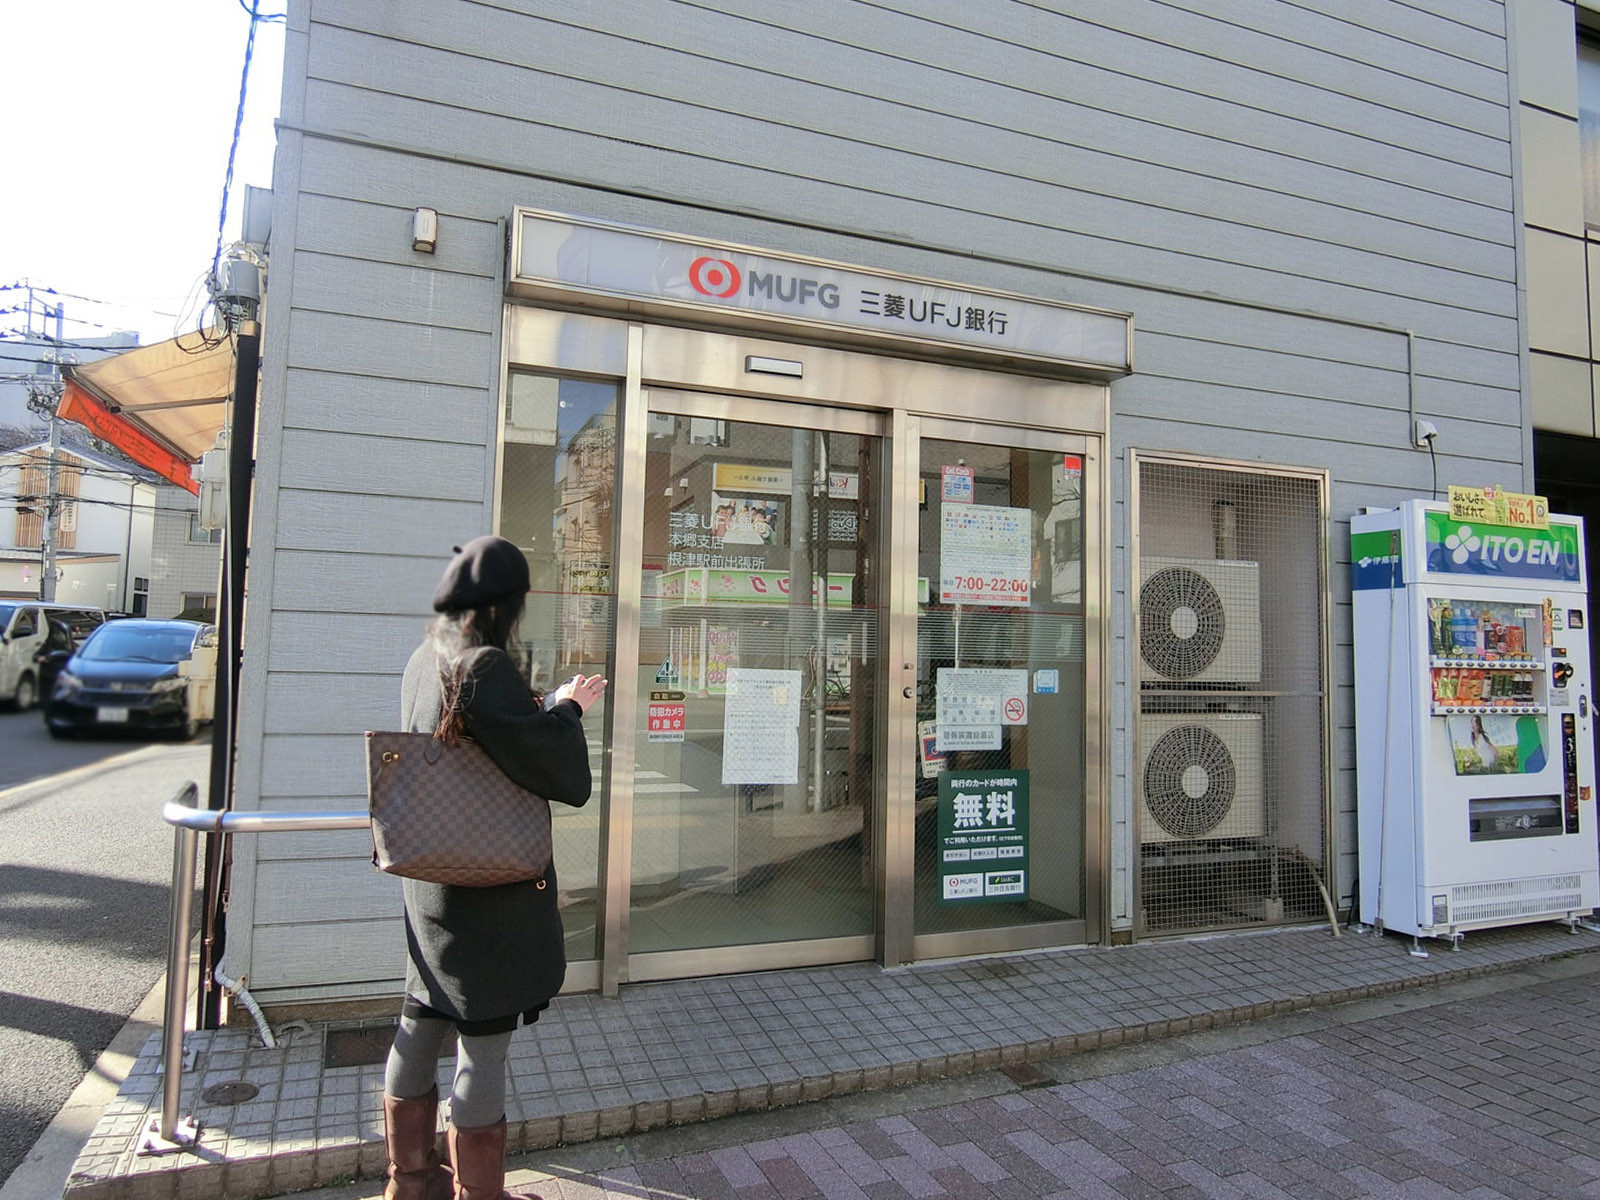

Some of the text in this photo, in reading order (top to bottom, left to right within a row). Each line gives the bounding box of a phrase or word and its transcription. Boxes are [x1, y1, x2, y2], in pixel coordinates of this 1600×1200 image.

[748, 269, 1008, 335] MUFG 三菱UFJ銀行
[1509, 499, 1535, 525] No.1
[668, 533, 724, 550] 本郷支店
[1480, 535, 1560, 565] ITO EN
[667, 551, 766, 570] 根津駅前出張所
[953, 791, 1016, 828] 無料
